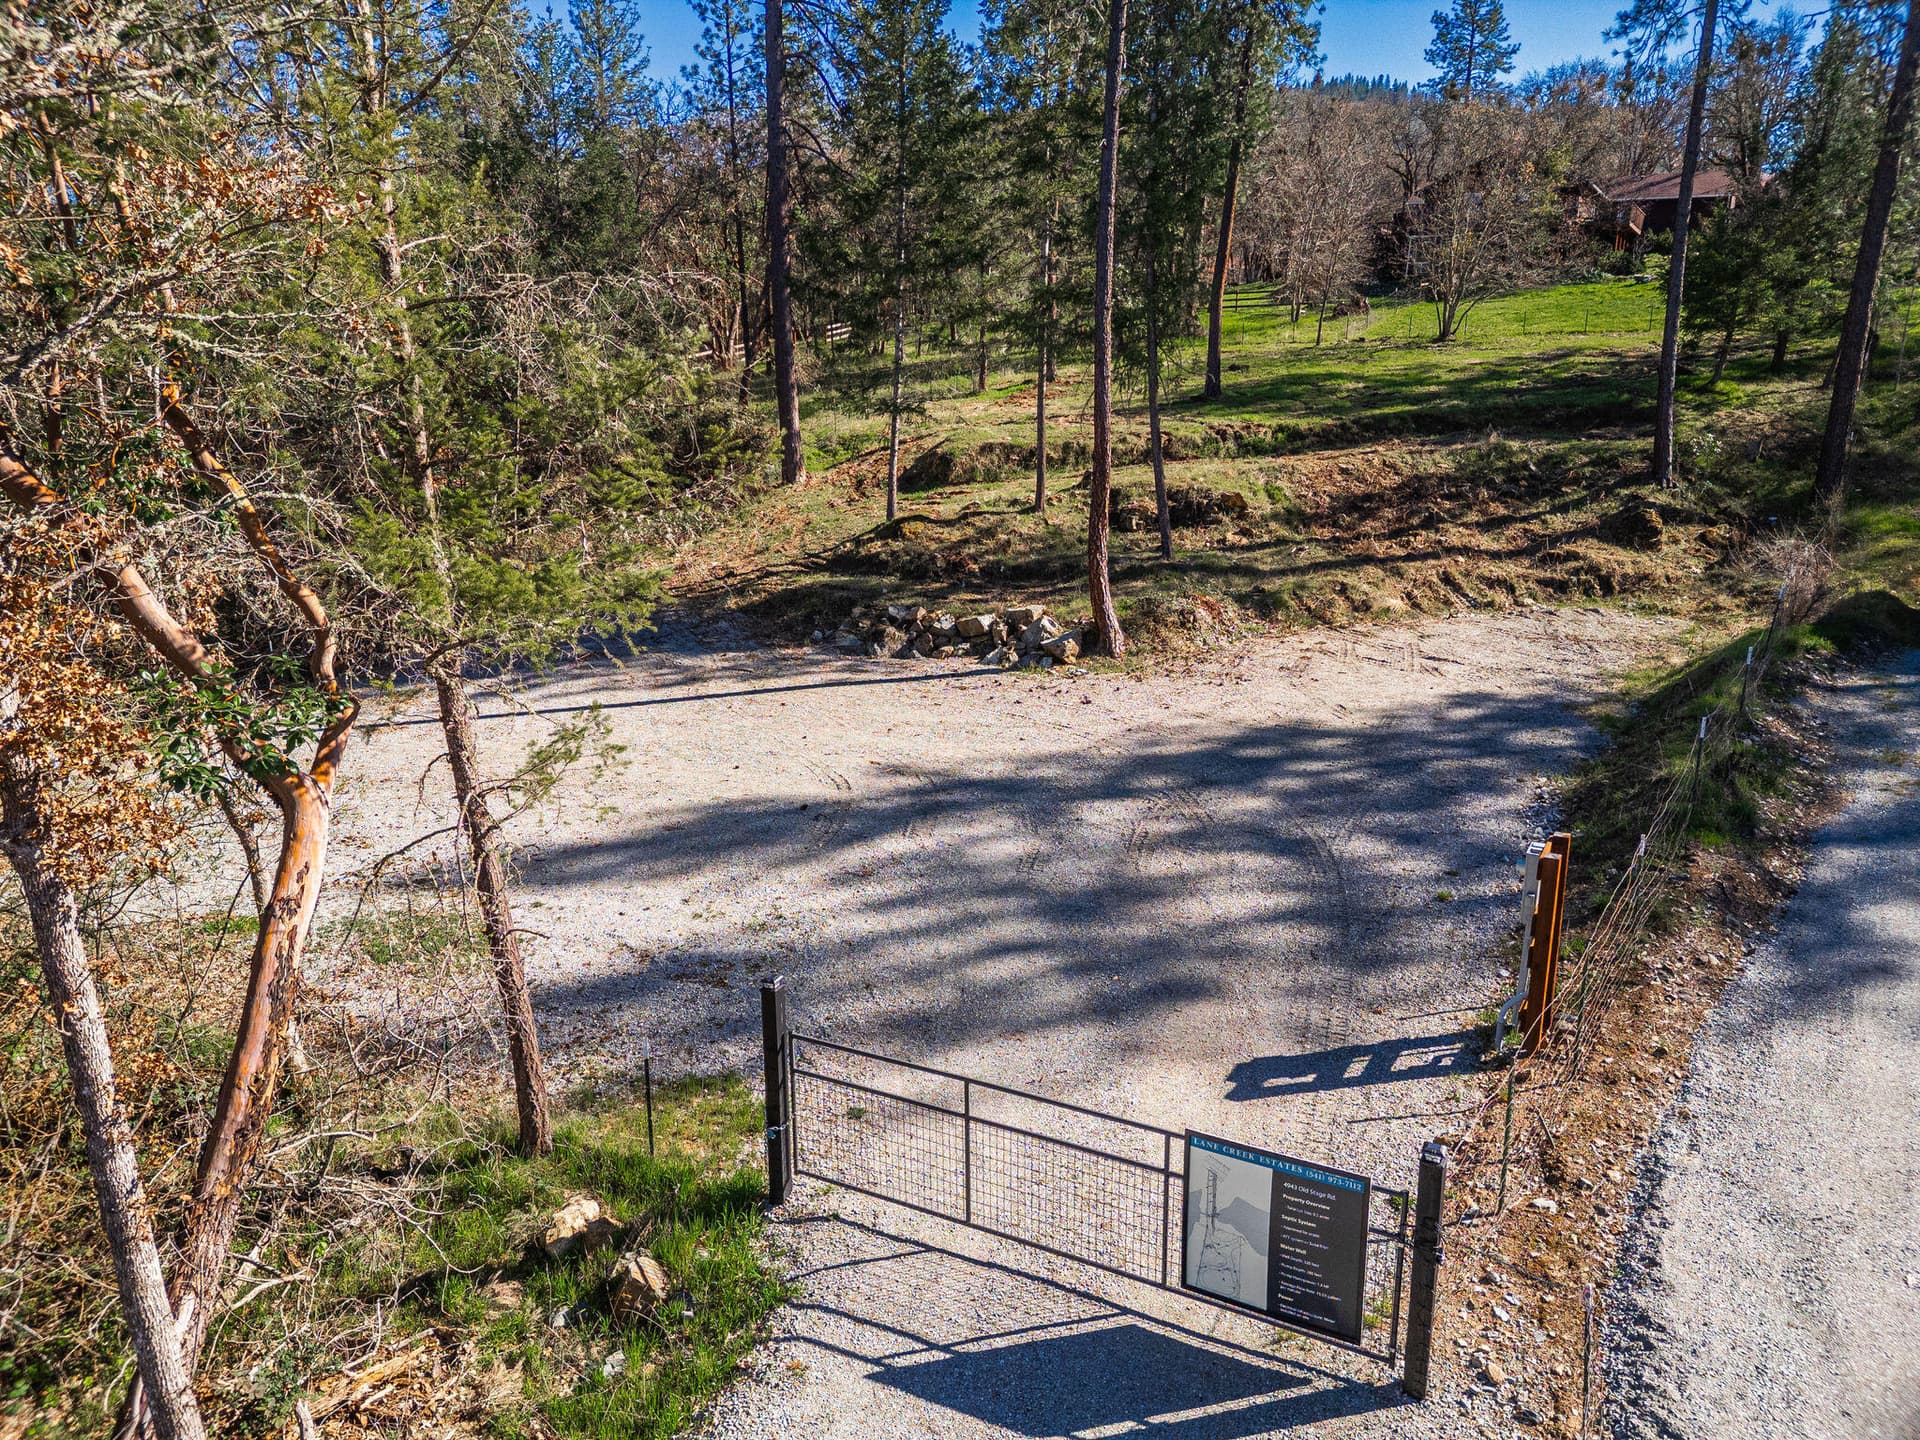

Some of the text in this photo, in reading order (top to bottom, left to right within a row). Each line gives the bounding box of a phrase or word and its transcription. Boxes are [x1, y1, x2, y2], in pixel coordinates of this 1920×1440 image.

[1193, 1137, 1219, 1151] LANE
[1222, 1145, 1255, 1160] CREEK
[1260, 1153, 1303, 1173] ESTATES
[1306, 1169, 1325, 1182] (541)
[1298, 1185, 1309, 1194] Old
[1282, 1194, 1330, 1210] Property Overview
[1281, 1214, 1317, 1228] Septic System
